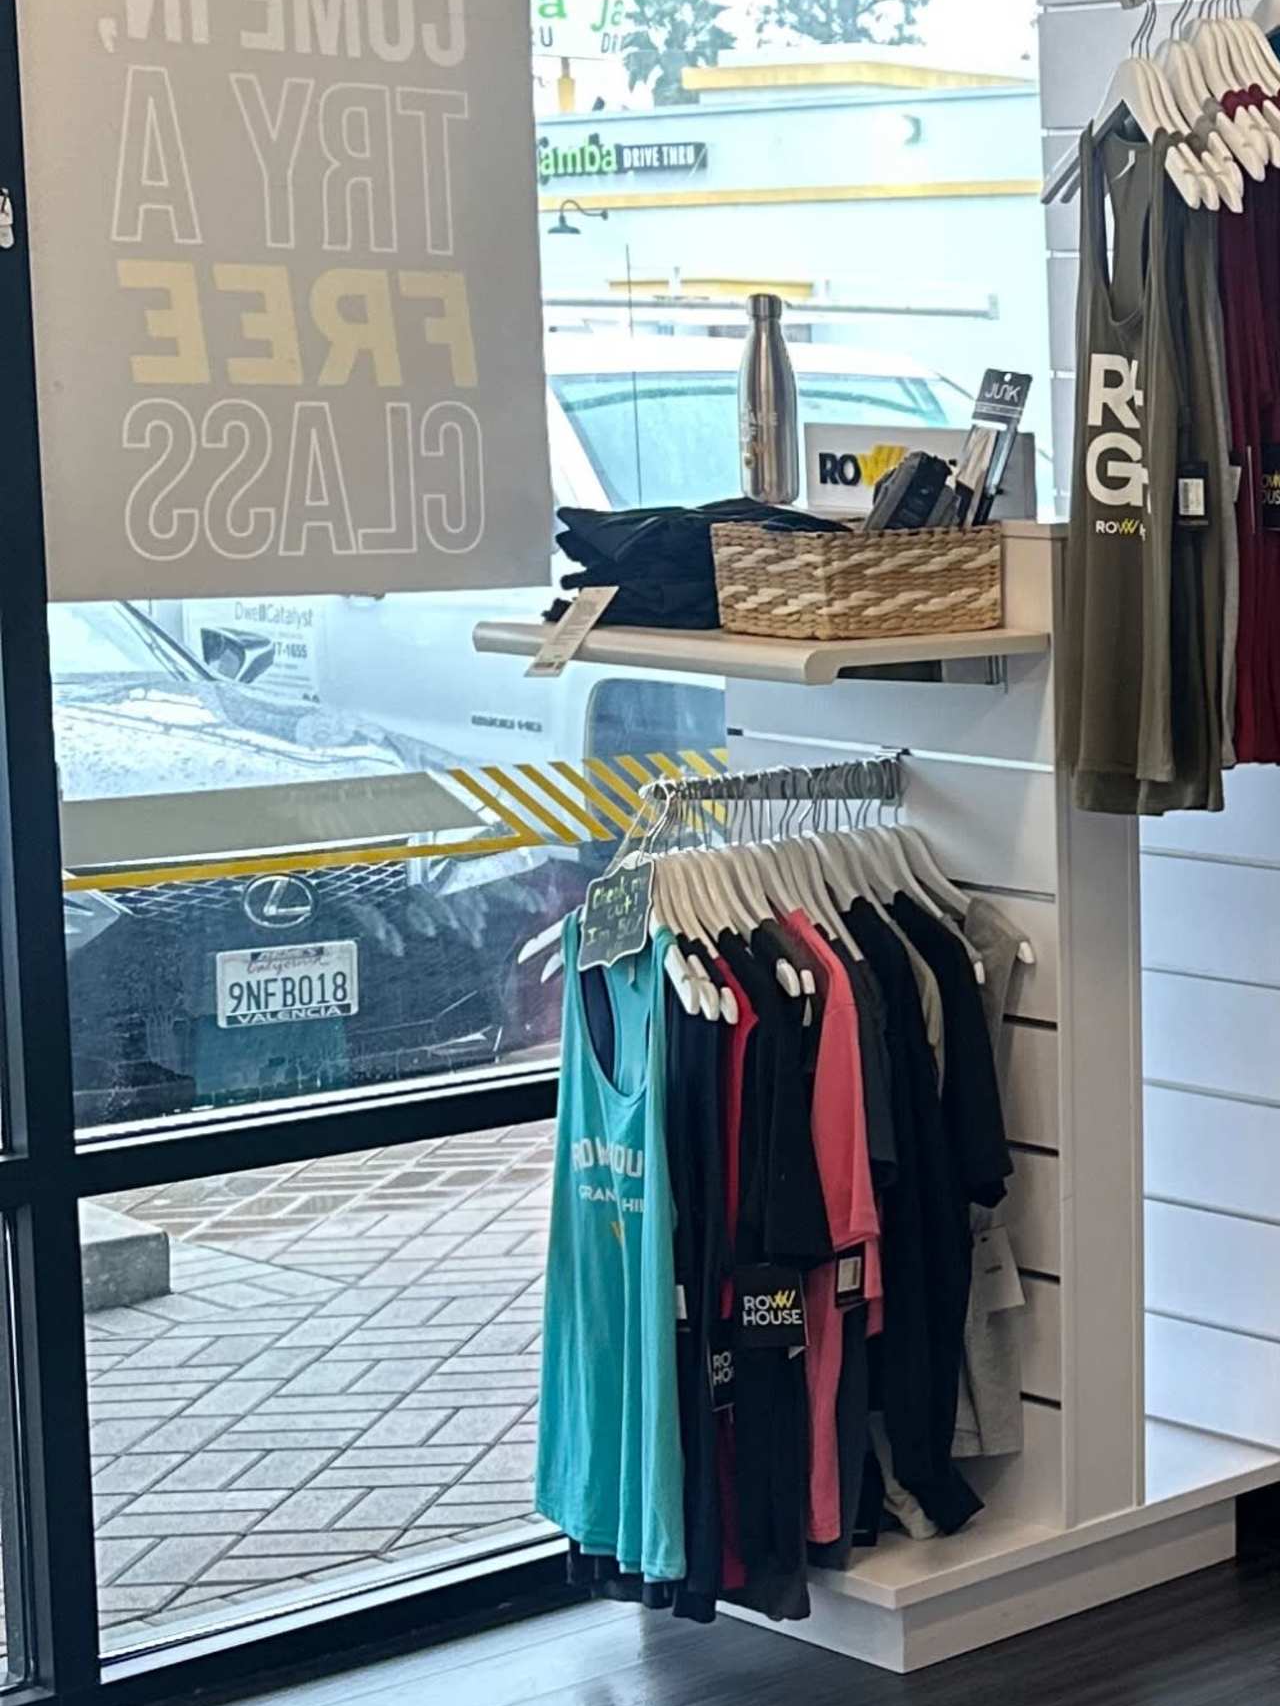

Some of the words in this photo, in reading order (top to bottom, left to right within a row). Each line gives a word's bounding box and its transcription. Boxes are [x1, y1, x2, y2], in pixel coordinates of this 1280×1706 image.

[623, 145, 659, 169] DRIVE
[661, 143, 696, 166] THRU
[984, 383, 1021, 403] JUNK
[229, 971, 348, 1014] 9NFB018
[237, 1005, 341, 1024] VALENCIA
[743, 1290, 796, 1310] ROW
[743, 1310, 803, 1326] HOUSE
